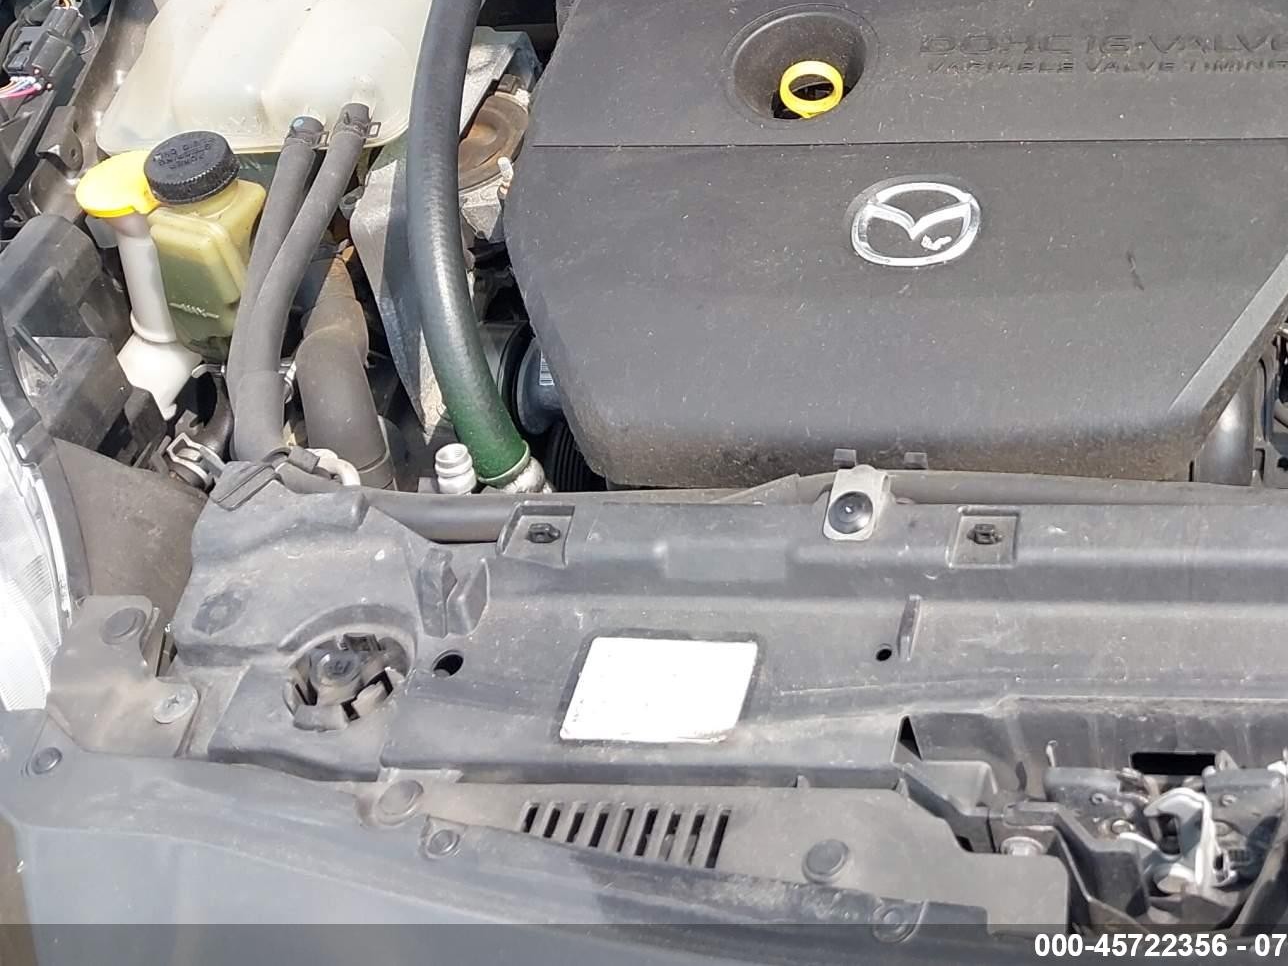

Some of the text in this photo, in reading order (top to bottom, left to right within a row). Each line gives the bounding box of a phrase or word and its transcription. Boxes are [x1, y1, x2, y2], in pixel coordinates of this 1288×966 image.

[919, 34, 1074, 56] DOHC
[926, 60, 1075, 75] VARIABLE
[1086, 60, 1177, 74] VALVE
